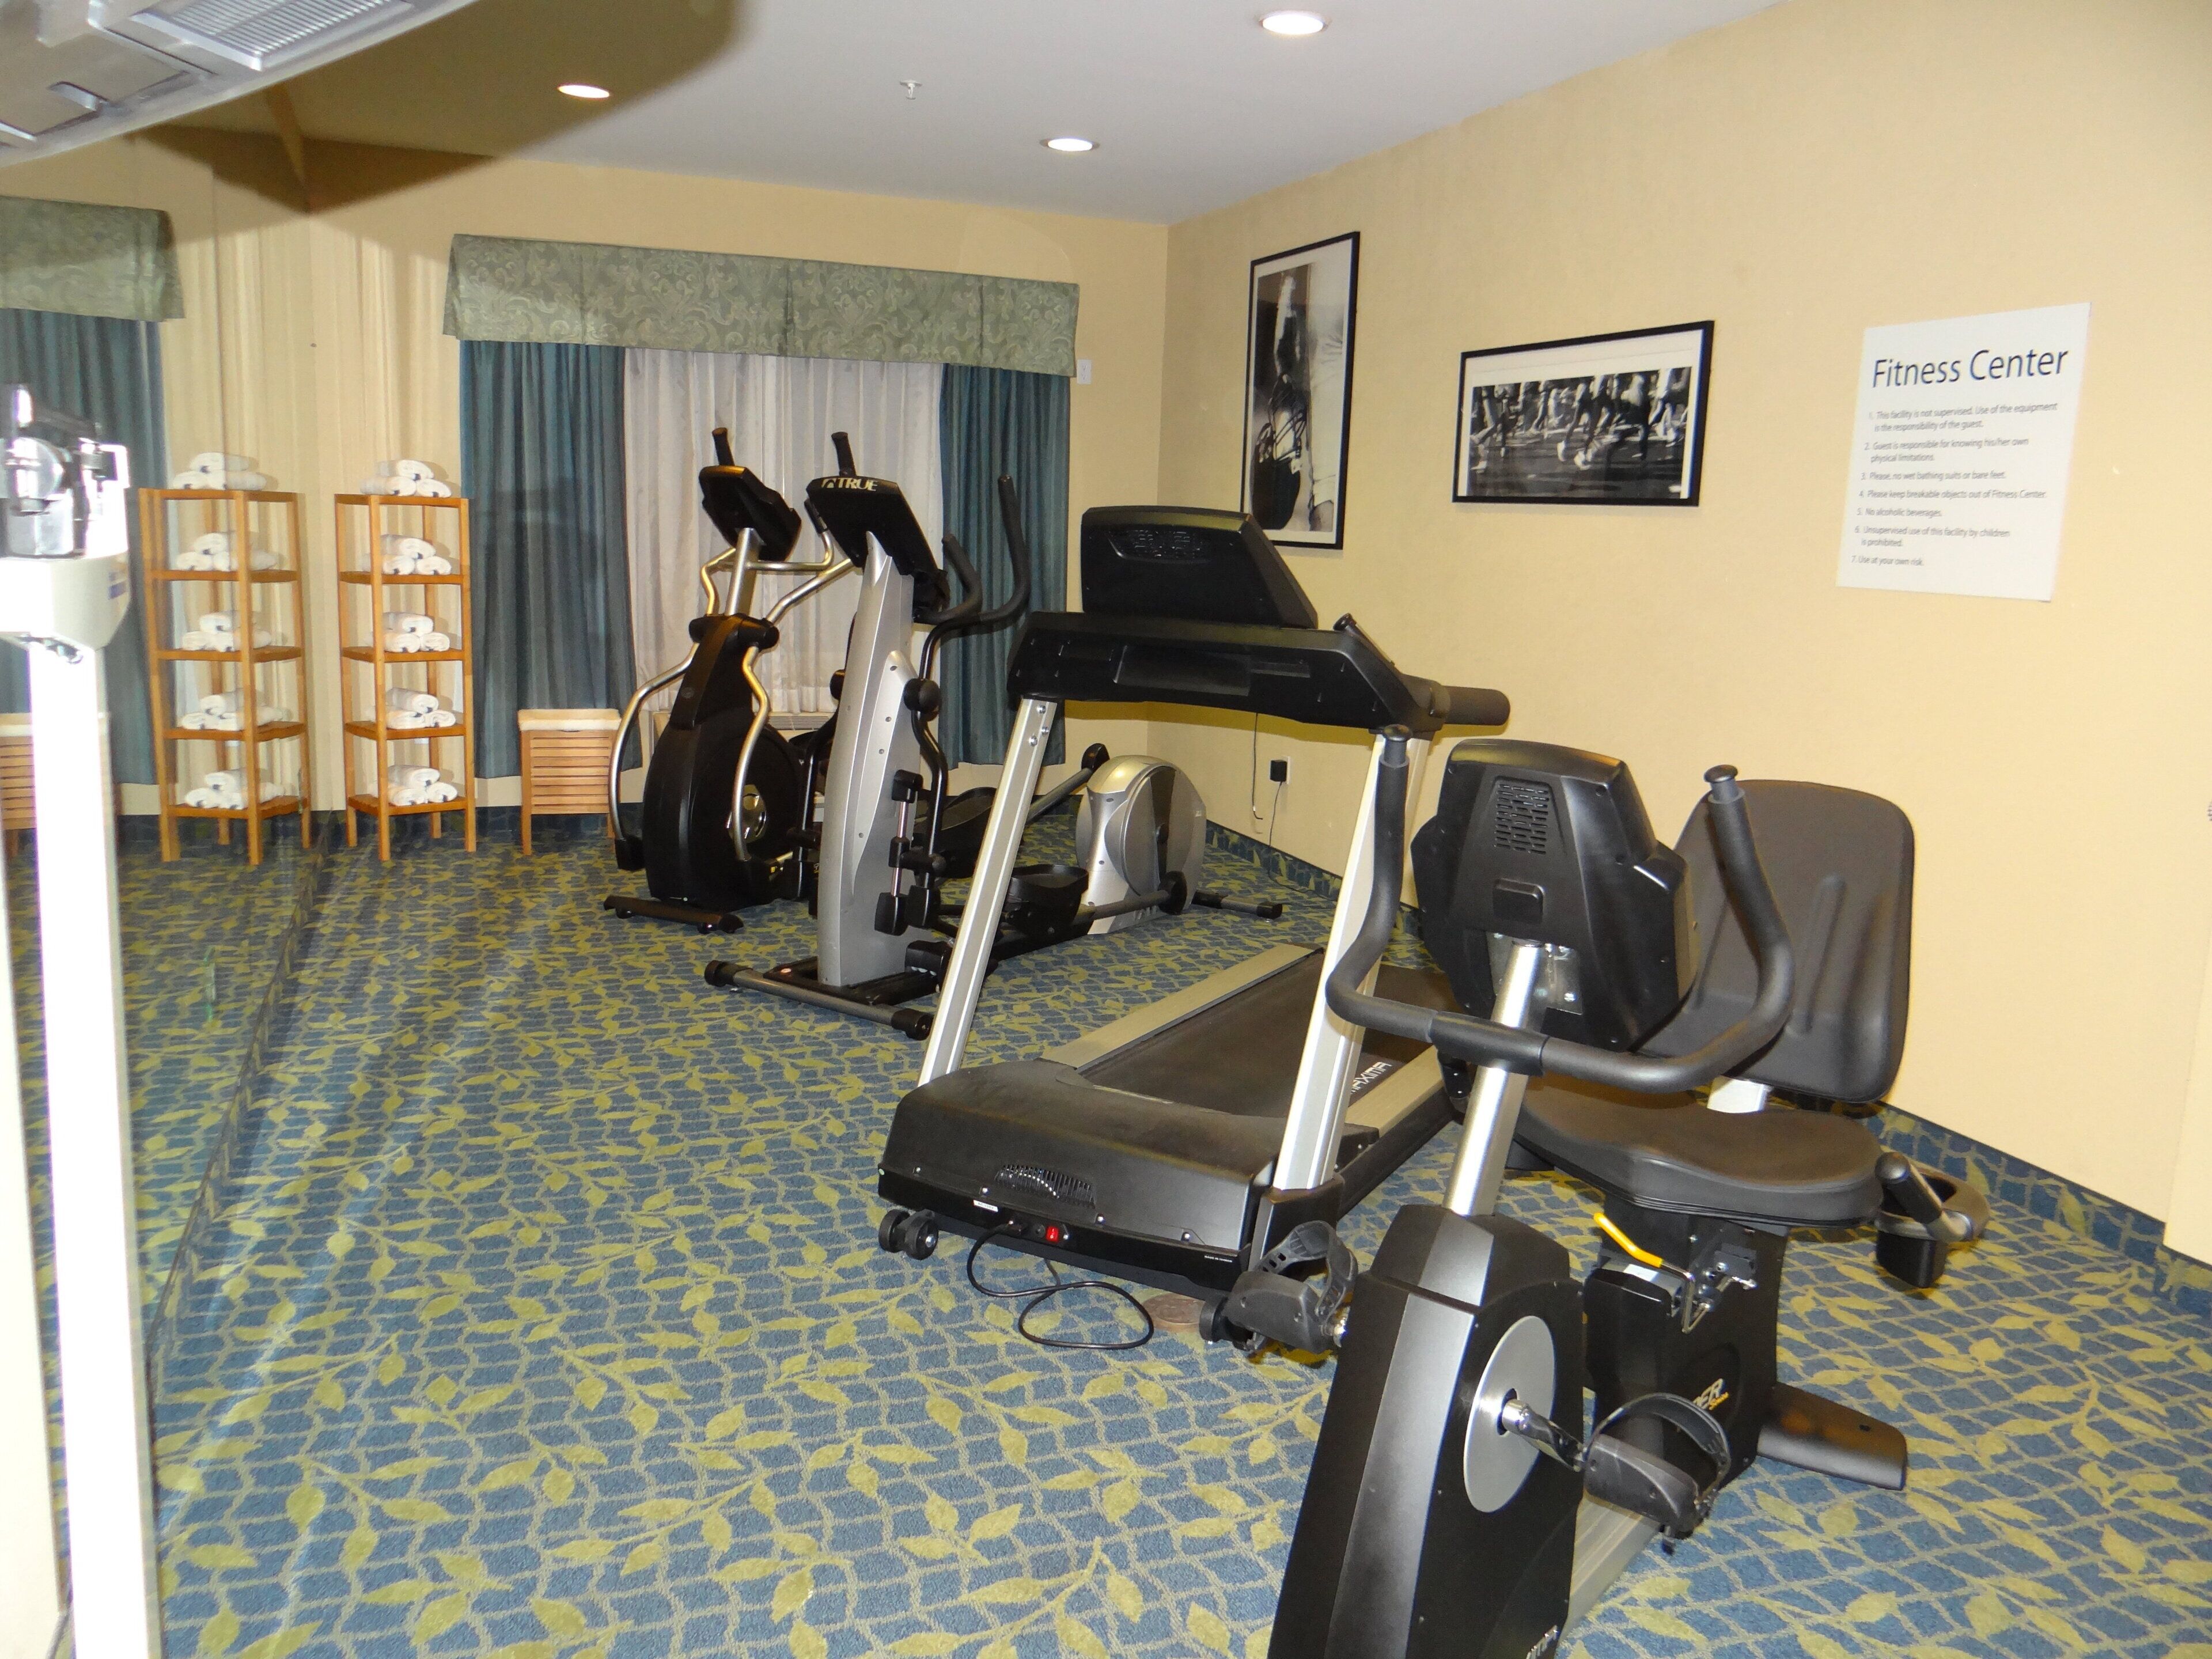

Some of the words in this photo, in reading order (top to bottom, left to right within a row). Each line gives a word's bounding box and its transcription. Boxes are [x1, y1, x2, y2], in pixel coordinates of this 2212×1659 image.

[1872, 358, 1961, 388] Fitness
[1969, 349, 2069, 381] Center
[1876, 411, 1890, 419] This
[1890, 410, 1912, 420] facility
[1913, 410, 1919, 418] is
[1975, 405, 1990, 414] Use
[1990, 404, 1999, 414] of
[1999, 404, 2013, 414] the
[2014, 403, 2058, 414] equipment
[1874, 424, 1880, 432] is
[1880, 423, 1892, 431] the
[1892, 422, 1938, 432] responsibility
[1939, 421, 1948, 429] of
[1948, 420, 1960, 429] the
[1872, 442, 1892, 450] Guest
[1892, 441, 1899, 449] is
[1899, 440, 1938, 450] responsible
[1939, 439, 1949, 448] for
[1951, 440, 1983, 449] knowing
[1870, 453, 1897, 464] physical
[1916, 471, 1944, 482] bathing
[1945, 471, 1961, 479] suits
[1972, 470, 1989, 479] bare
[836, 477, 878, 491] TRUE
[1868, 490, 1889, 498] Please
[1889, 490, 1906, 499] keep
[1906, 489, 1940, 498] breakable
[1941, 490, 1967, 500] objects
[1982, 490, 1992, 498] of
[1992, 490, 2018, 498] Fitness
[1876, 508, 1904, 516] alcoholic
[1863, 525, 1908, 535] Unsupervised
[1922, 527, 1930, 535] of
[1930, 527, 1943, 535] this
[1944, 527, 1968, 538] facility
[1968, 527, 1979, 539] by
[1980, 527, 2010, 537] children
[1858, 555, 1870, 563] Use
[1878, 558, 1894, 566] your
